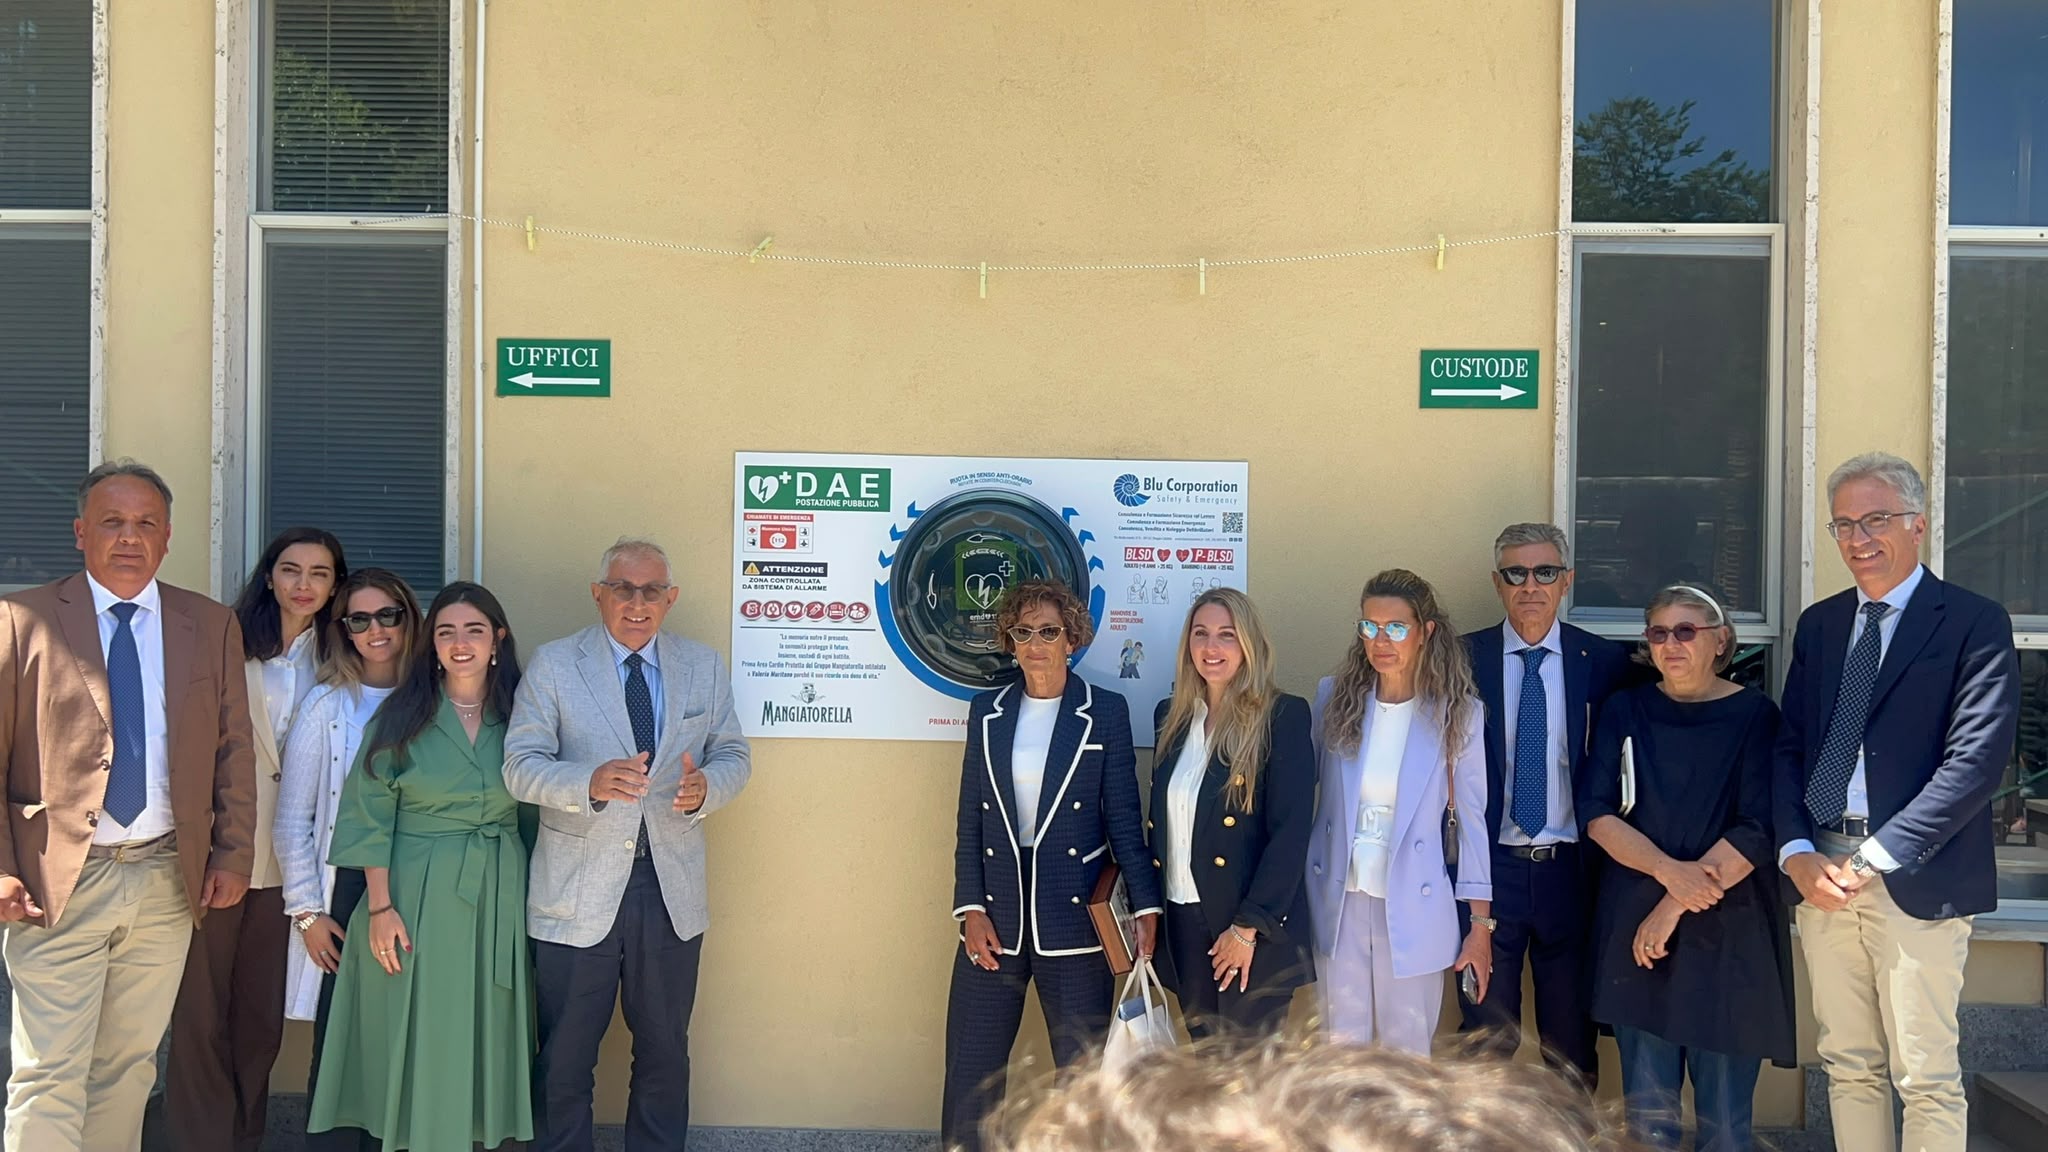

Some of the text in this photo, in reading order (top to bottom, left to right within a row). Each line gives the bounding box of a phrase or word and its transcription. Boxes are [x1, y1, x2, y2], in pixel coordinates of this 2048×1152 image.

[506, 346, 599, 368] UFFICI
[1430, 357, 1528, 378] CUSTODE
[796, 472, 880, 498] DAE
[950, 475, 968, 484] RUOTA
[996, 472, 1032, 486] ANTI-ORARIO
[1144, 477, 1238, 494] Blu Corporation
[796, 498, 840, 506] POSTAZIONE
[1156, 494, 1182, 504] Safety
[1194, 496, 1238, 504] Emergency
[1126, 548, 1152, 560] BLSD
[1195, 549, 1233, 562] P-BLSD
[762, 565, 824, 573] ATTENZIONE
[761, 700, 852, 726] MANGIATORELLA
